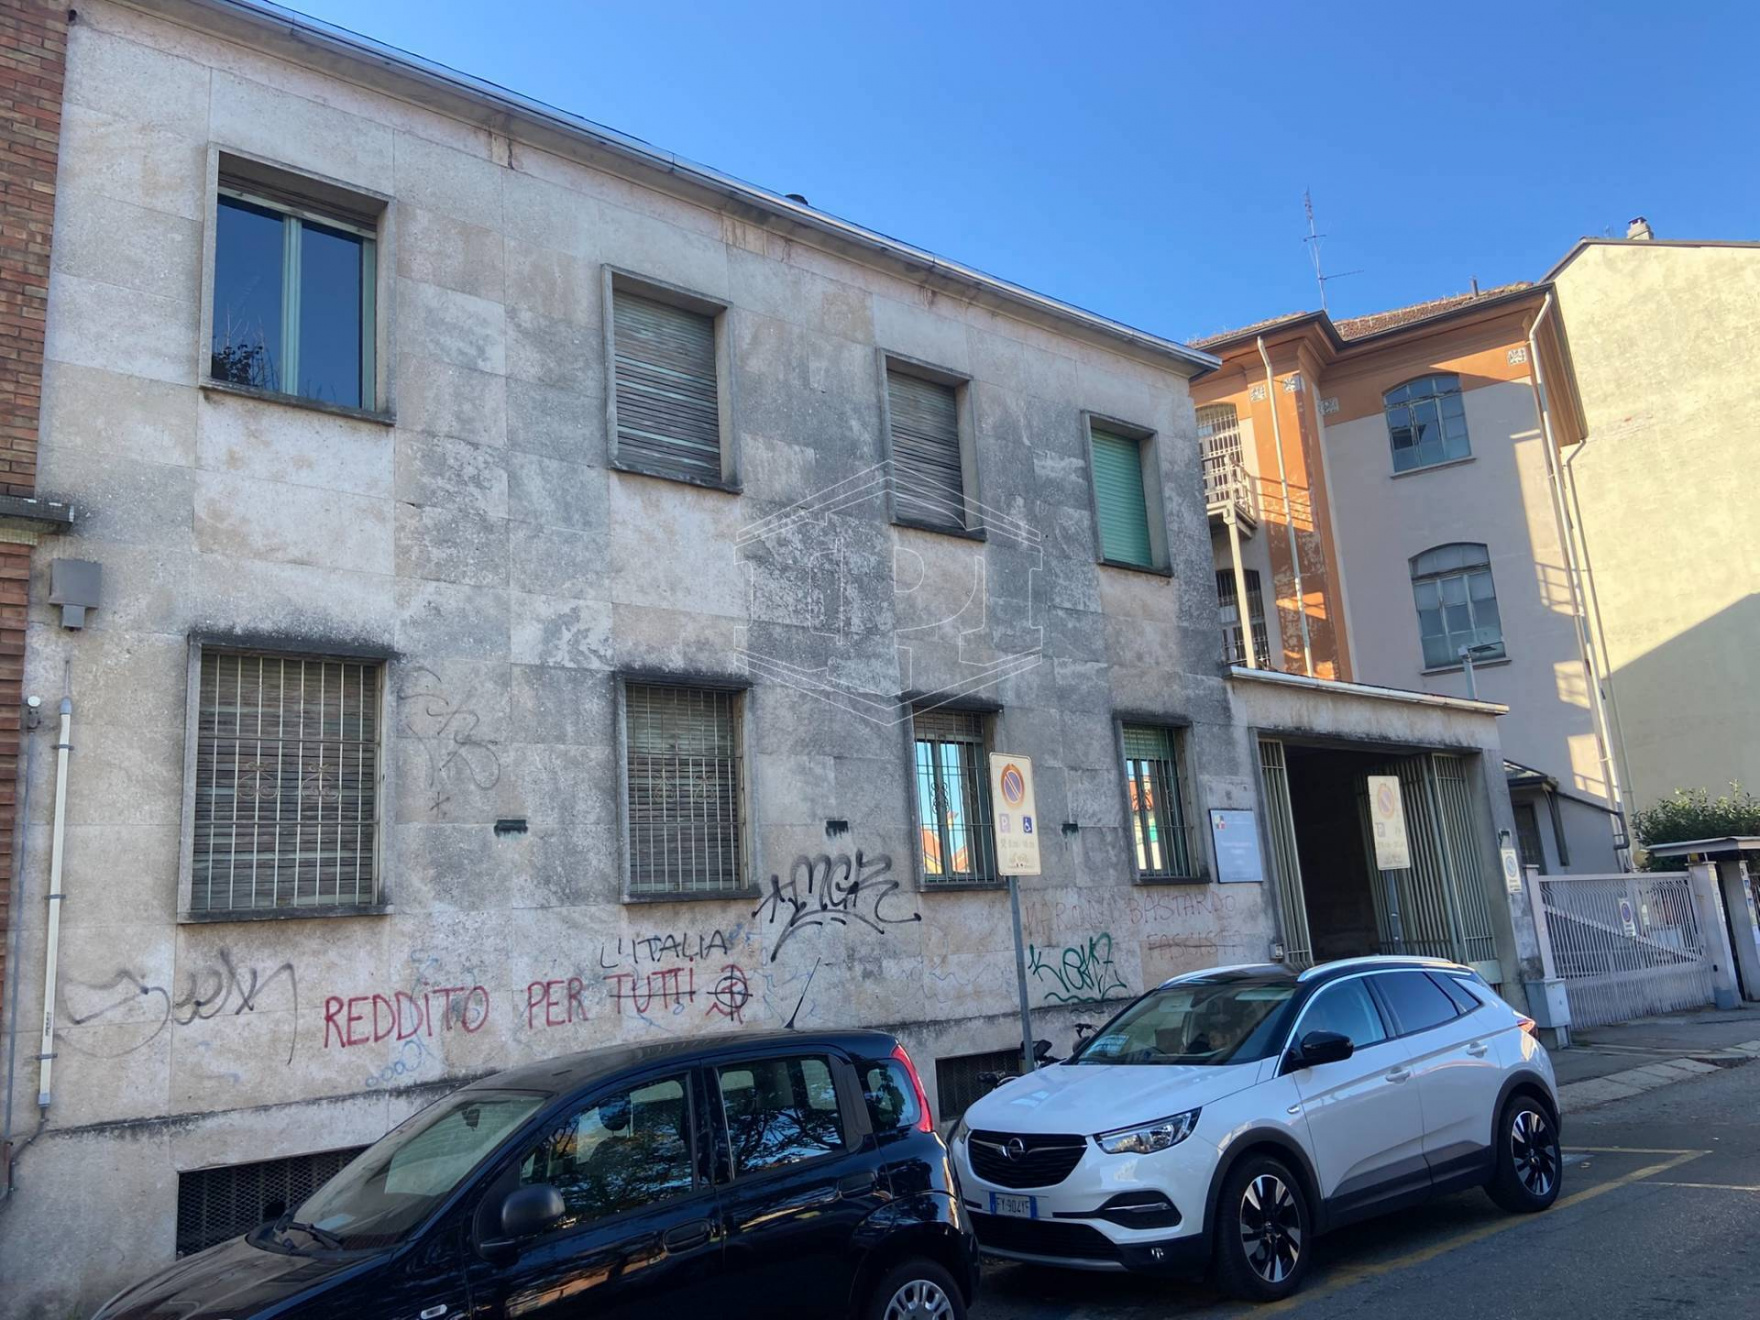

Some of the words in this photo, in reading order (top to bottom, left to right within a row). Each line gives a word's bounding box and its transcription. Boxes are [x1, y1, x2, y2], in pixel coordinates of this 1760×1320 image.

[1128, 890, 1237, 925] BASTARDO
[600, 930, 728, 968] L'ITALIA
[527, 976, 589, 1030] PER
